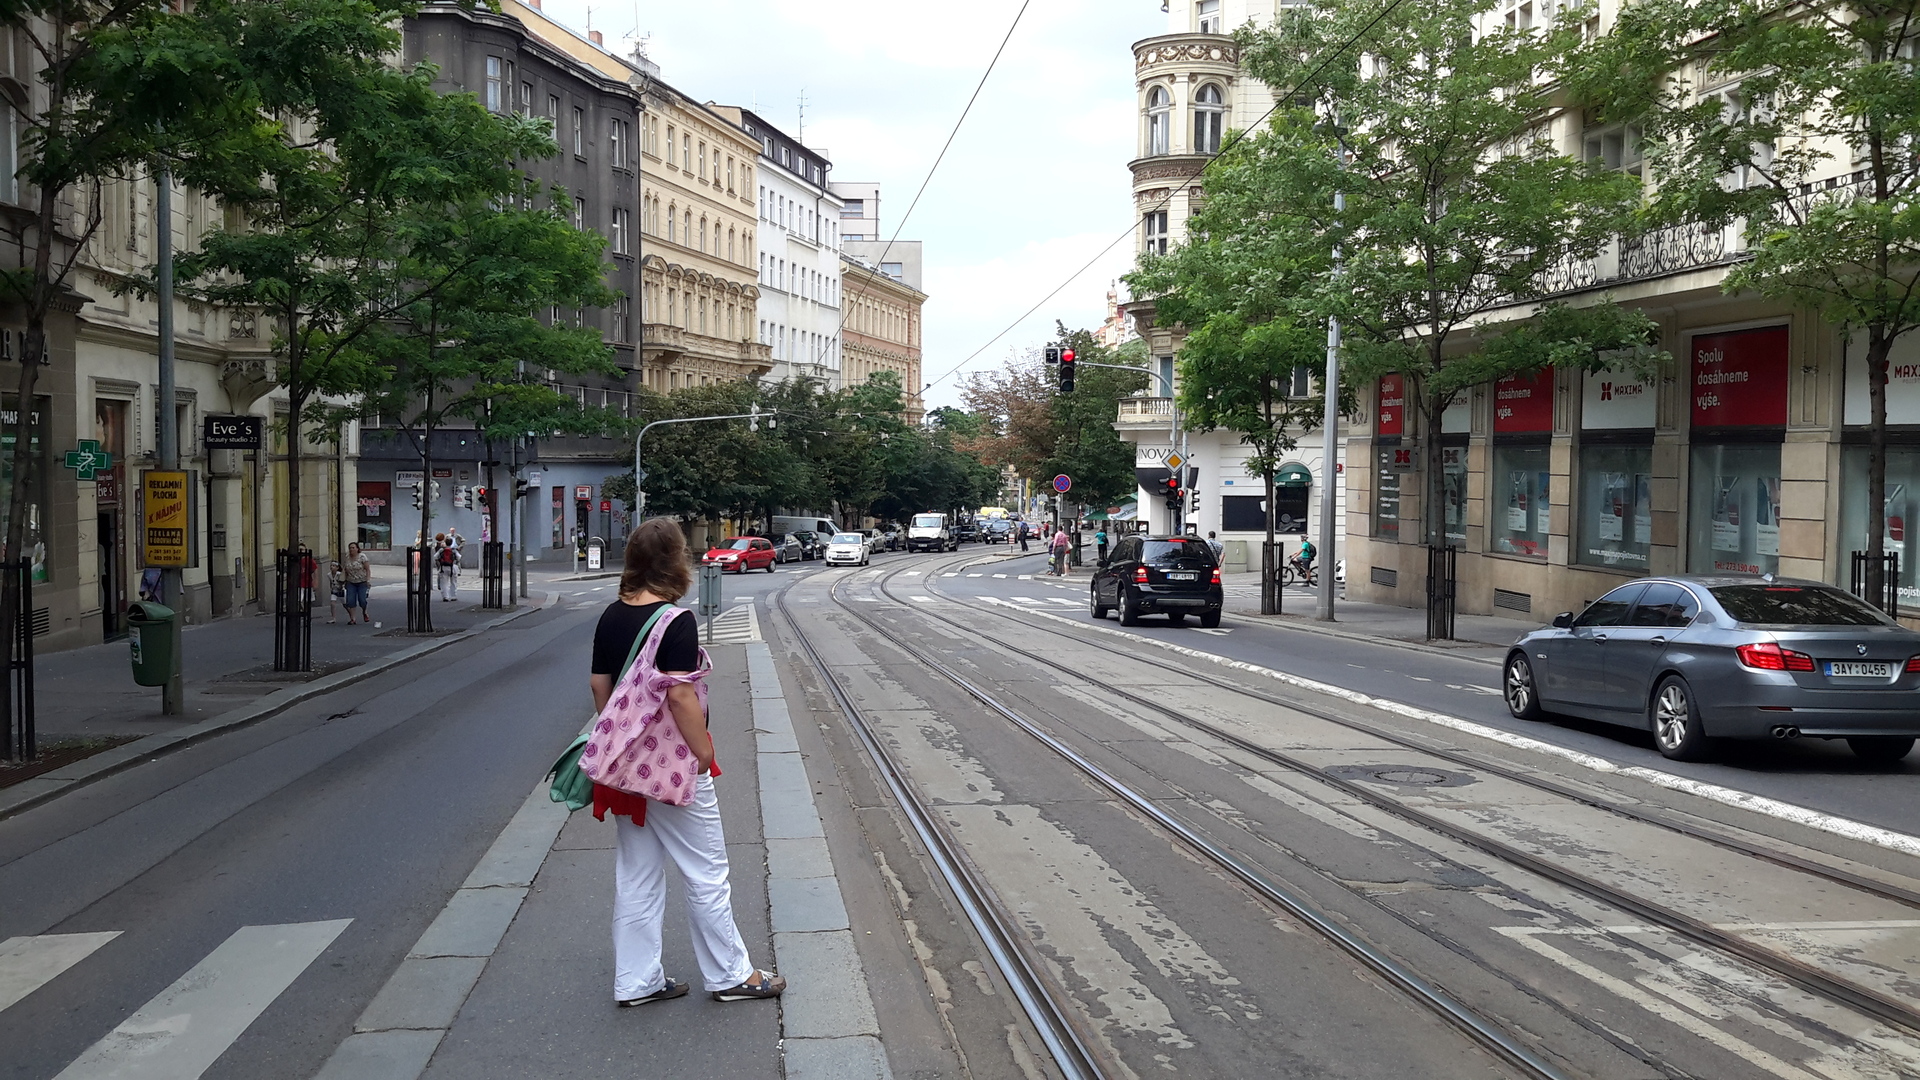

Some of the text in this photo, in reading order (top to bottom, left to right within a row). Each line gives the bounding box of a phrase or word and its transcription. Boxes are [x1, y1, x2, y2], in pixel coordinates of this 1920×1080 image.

[1698, 347, 1724, 366] Spolu
[1697, 369, 1749, 385] dosáhneme
[1497, 387, 1531, 400] dosáhneme
[1614, 384, 1643, 396] MAXIMA
[1696, 391, 1721, 410] výše.
[1497, 404, 1514, 420] výše.
[206, 436, 228, 444] Beauty
[148, 479, 182, 489] REKLAMNÍ
[152, 491, 177, 500] PLOCHA
[148, 501, 182, 524] K NÁJMU
